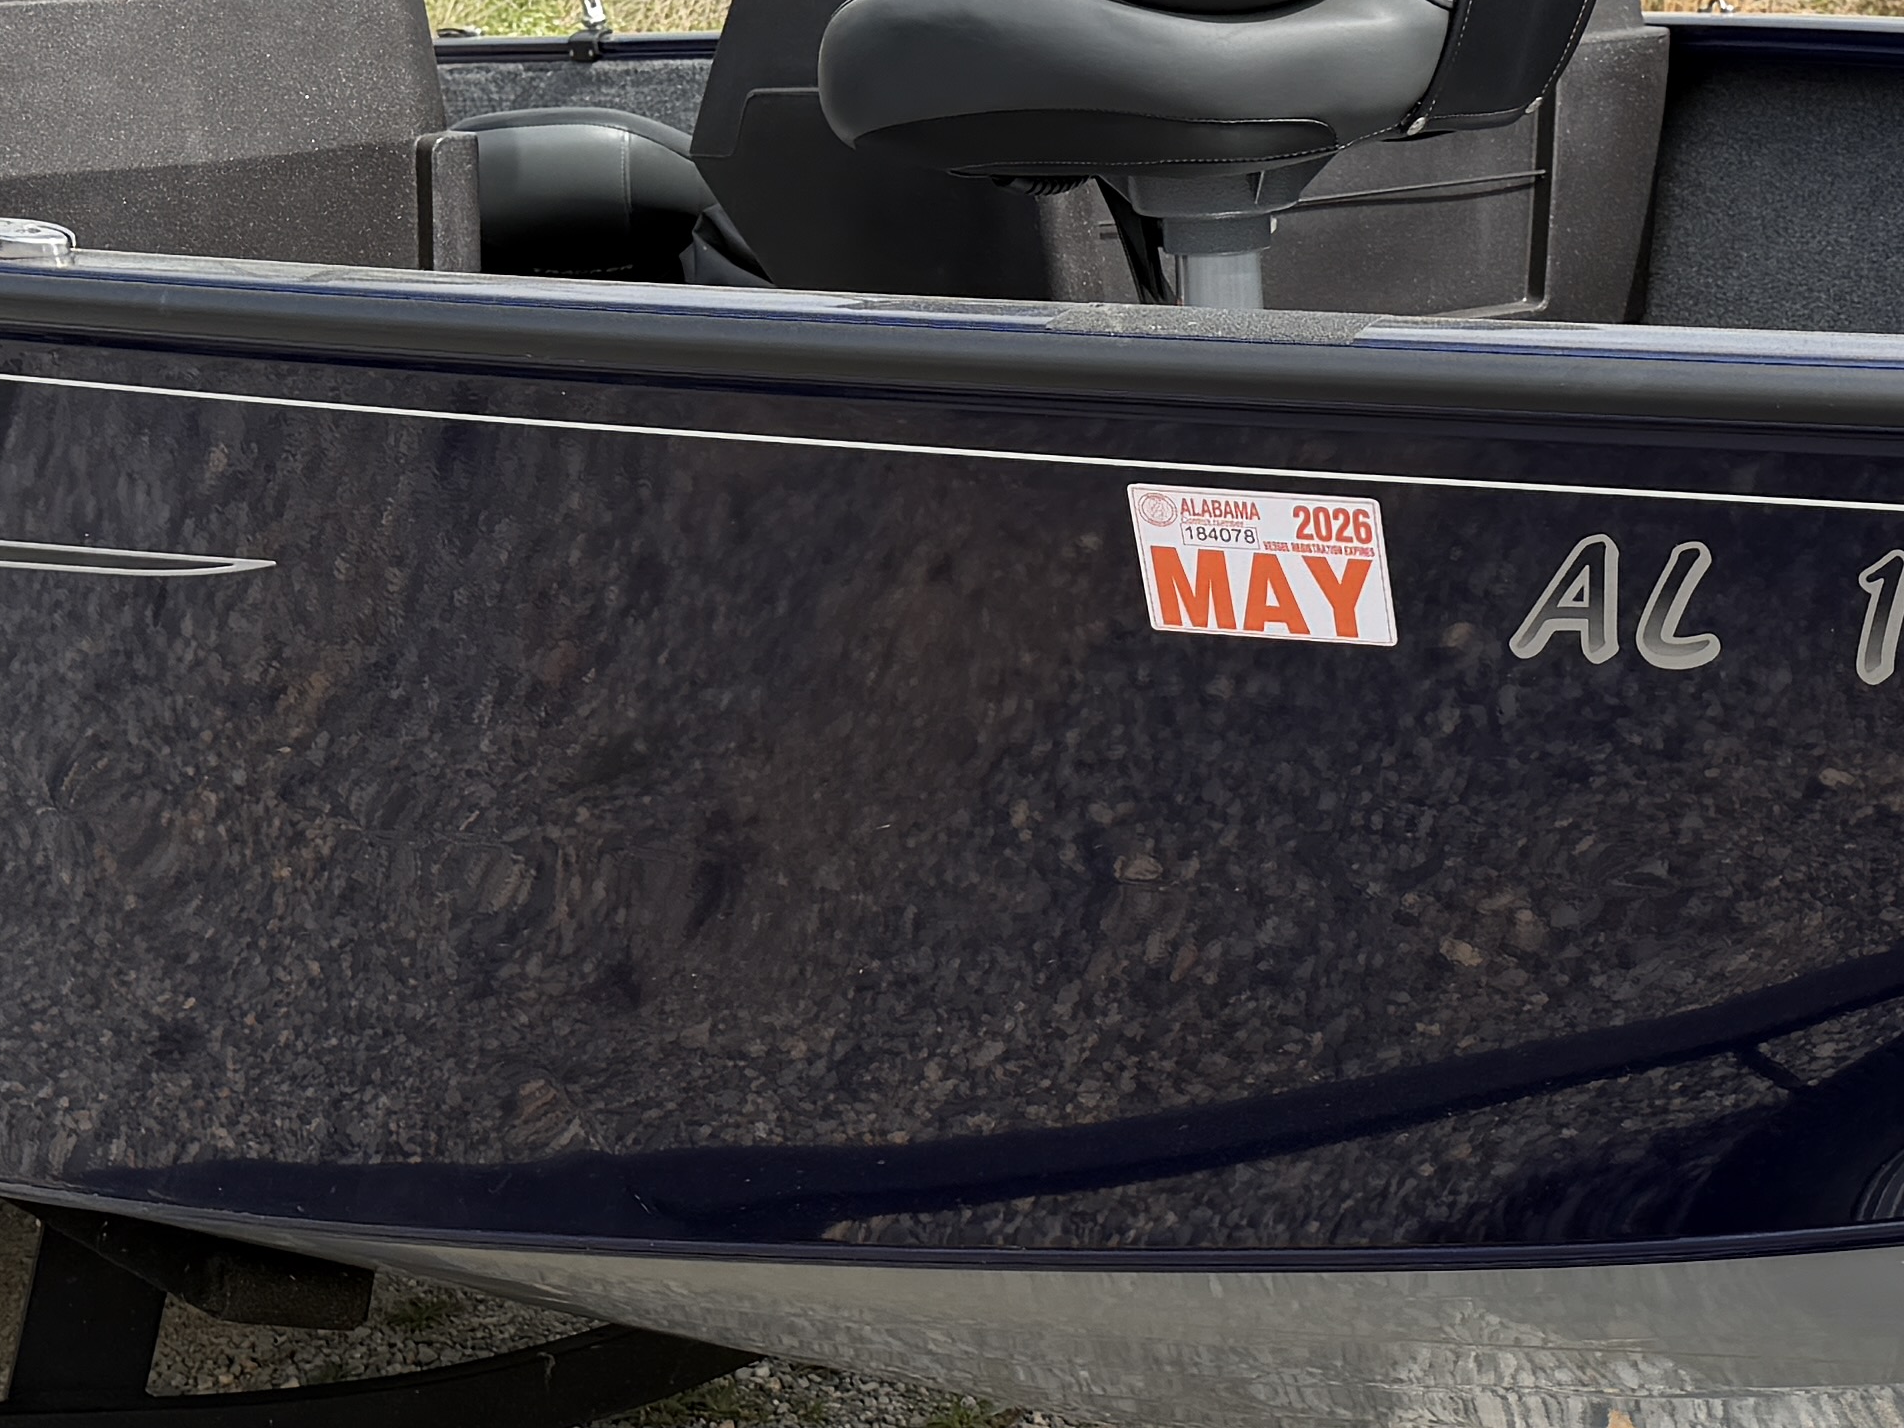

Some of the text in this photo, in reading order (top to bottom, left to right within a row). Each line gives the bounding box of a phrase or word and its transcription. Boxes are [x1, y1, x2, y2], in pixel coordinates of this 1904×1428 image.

[1180, 498, 1261, 521] ALABAMA
[1292, 505, 1374, 545] 2026
[1185, 526, 1256, 545] 184078
[1150, 545, 1373, 639] MAY
[1509, 533, 1722, 670] AL
